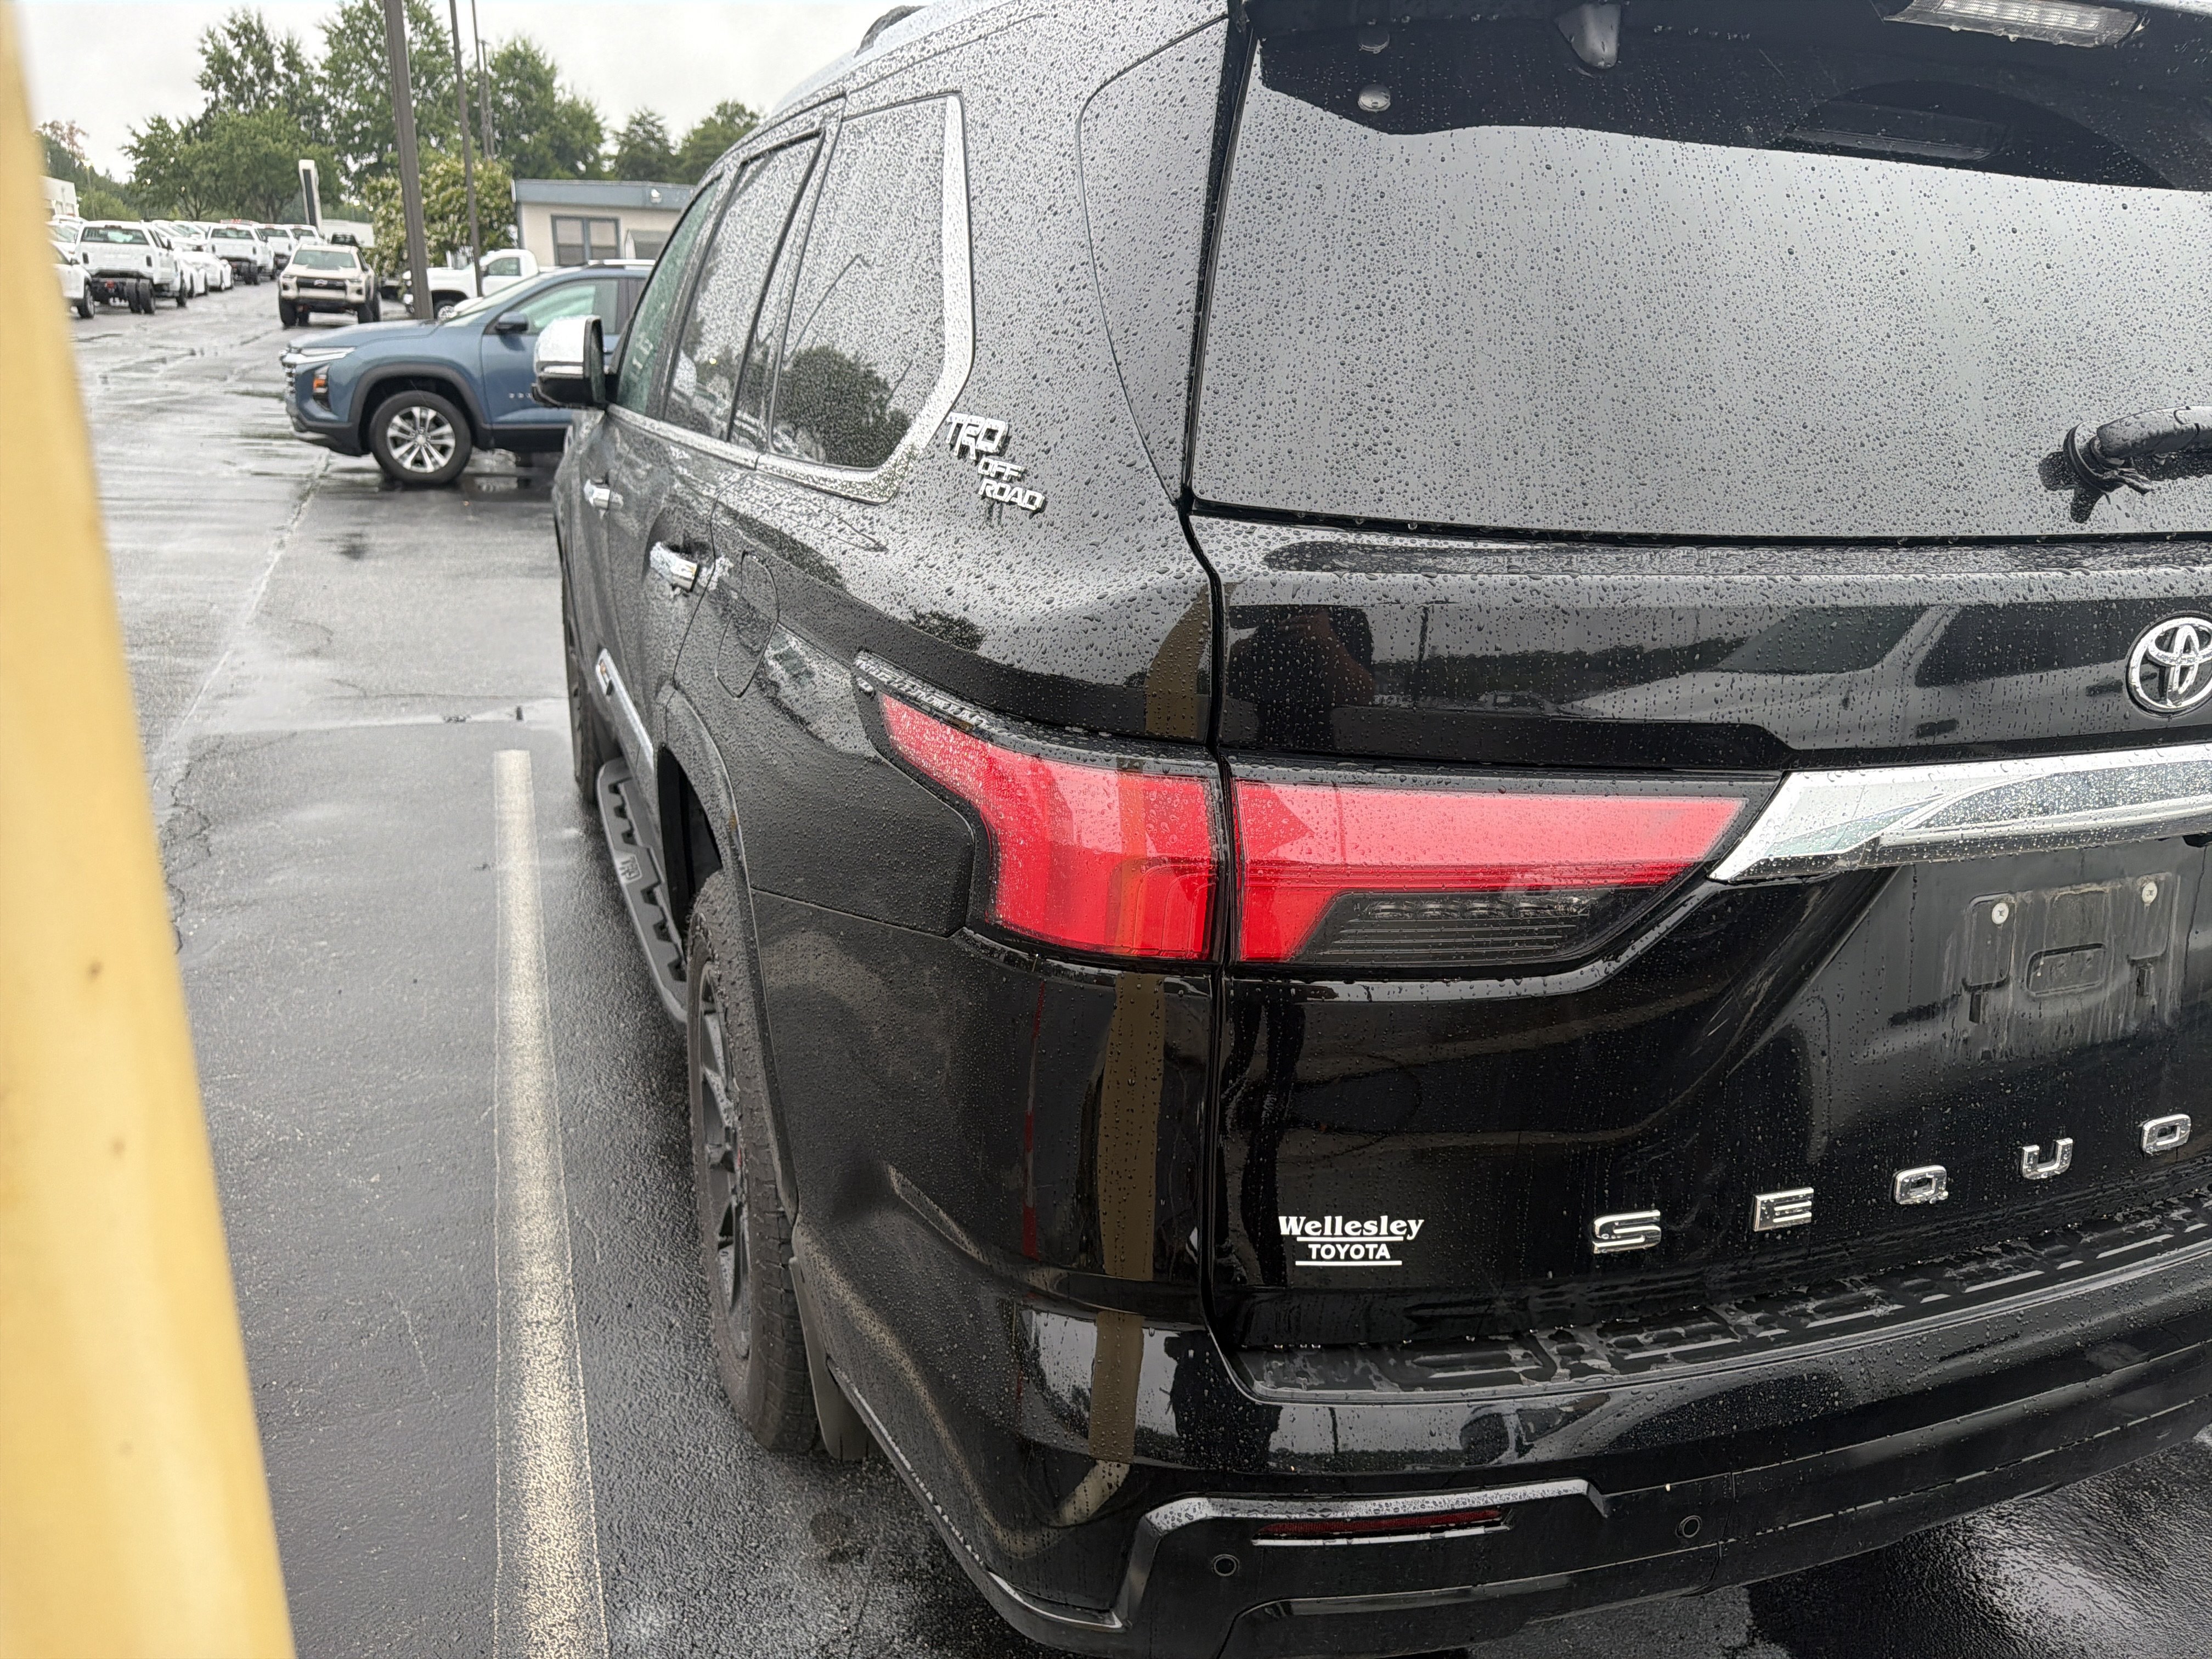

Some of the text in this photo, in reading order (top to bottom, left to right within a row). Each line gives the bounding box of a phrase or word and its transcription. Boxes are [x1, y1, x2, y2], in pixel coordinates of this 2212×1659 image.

[946, 413, 1008, 460] TRD
[978, 458, 1023, 481] OFF
[978, 478, 1045, 511] ROAD
[1278, 1215, 1425, 1240] Wellesley
[1308, 1243, 1391, 1260] TOYOTA
